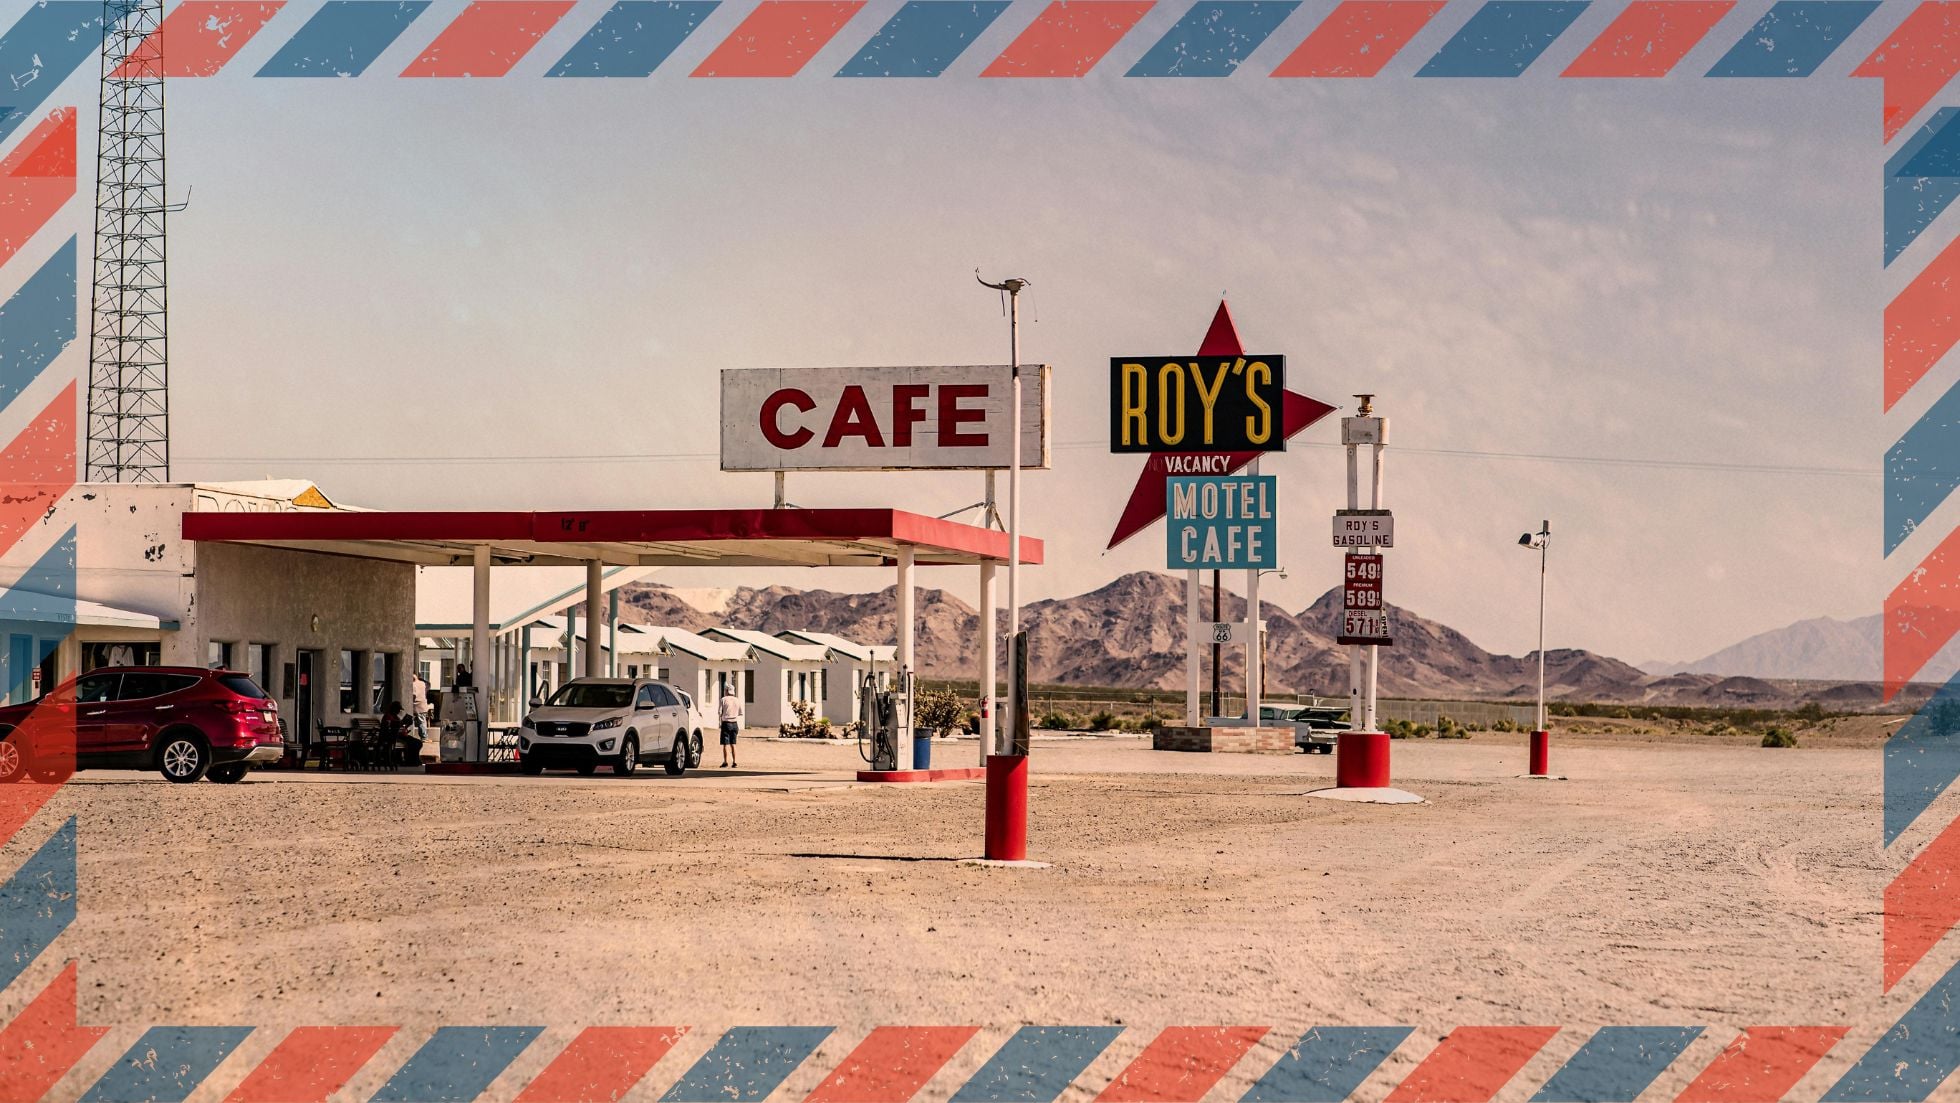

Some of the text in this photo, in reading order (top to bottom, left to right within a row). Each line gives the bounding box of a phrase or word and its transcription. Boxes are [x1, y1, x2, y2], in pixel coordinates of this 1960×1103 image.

[1121, 357, 1272, 446] ROY'S
[759, 384, 989, 450] CAFE
[1164, 455, 1231, 473] VACANCY
[1173, 482, 1271, 520] MOTEL
[1346, 520, 1379, 532] ROY'S
[1181, 525, 1262, 563] CAFE
[1333, 535, 1389, 546] GASOLINE
[1216, 632, 1228, 641] 66
